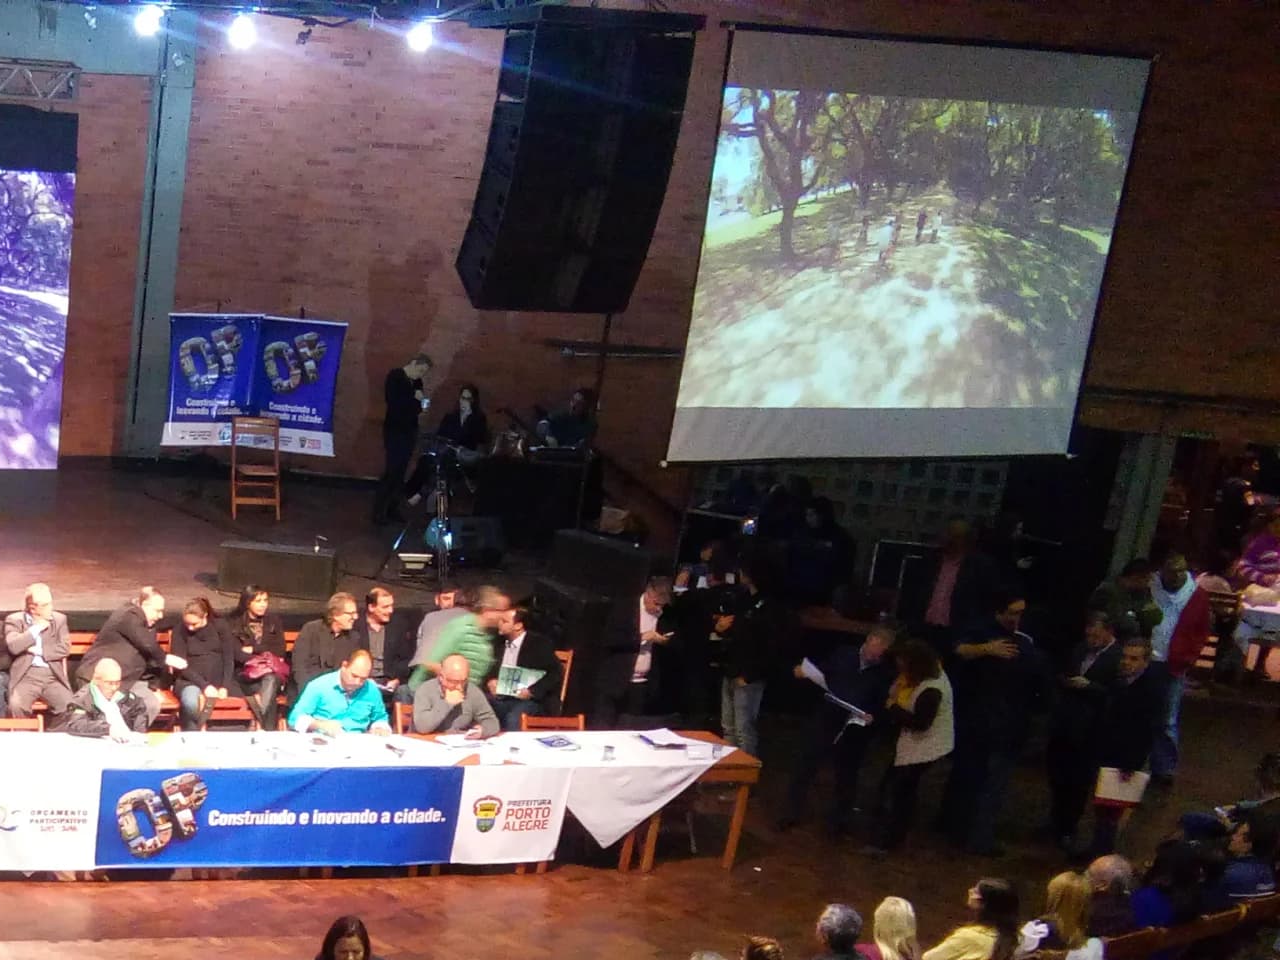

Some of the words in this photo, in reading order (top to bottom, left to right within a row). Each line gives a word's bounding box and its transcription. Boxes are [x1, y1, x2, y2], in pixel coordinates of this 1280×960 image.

[507, 799, 552, 807] PREFEITURA
[208, 809, 296, 826] Construindo
[299, 812, 309, 825] e
[312, 808, 378, 825] inovando
[380, 811, 391, 824] a
[394, 807, 447, 824] cidade.
[505, 806, 551, 820] PORTO
[502, 819, 550, 832] ALEGRE
